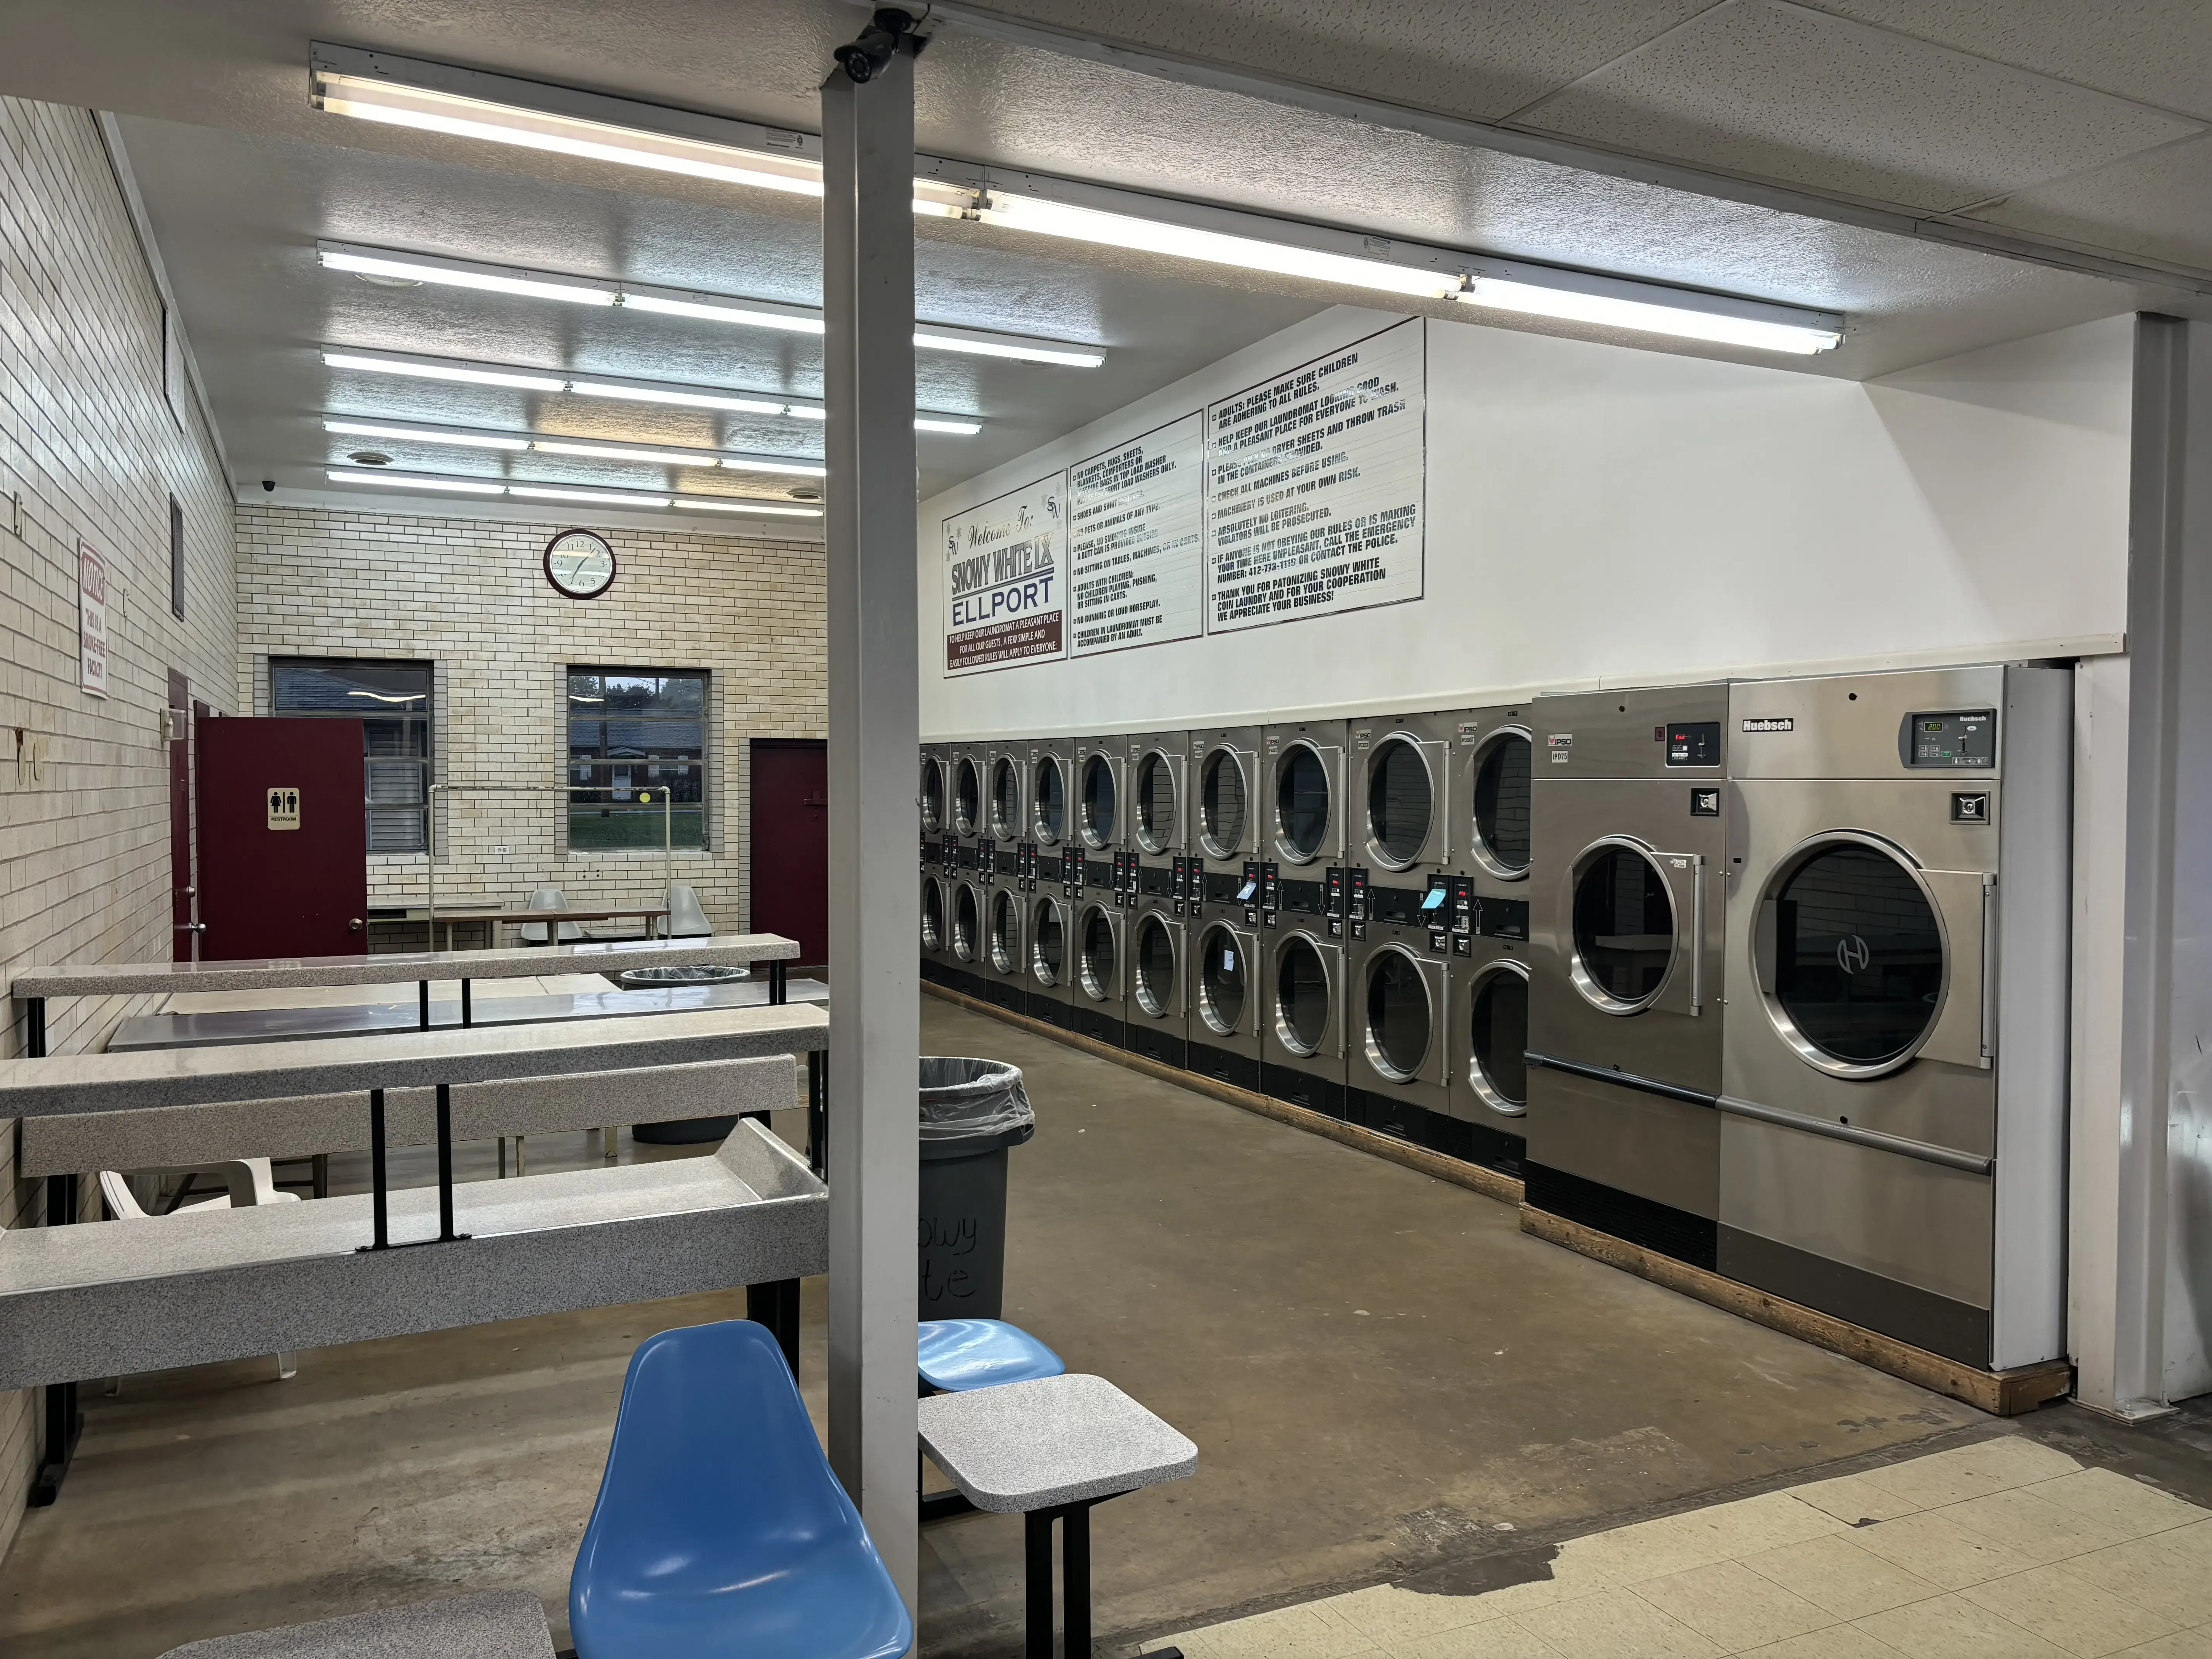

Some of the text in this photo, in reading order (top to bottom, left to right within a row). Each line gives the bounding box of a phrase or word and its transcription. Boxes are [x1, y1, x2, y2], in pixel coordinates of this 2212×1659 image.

[1219, 352, 1357, 419] ADULTS: PLEASE MAKE SURE CHILDREN
[1219, 381, 1319, 429] ARE ADHERING TO ALL RULES.
[1077, 471, 1083, 480] NO
[1085, 461, 1106, 477] CARPETS,
[1108, 454, 1121, 467] RUGS,
[1077, 455, 1142, 489] BLANKETS, COMFORTERS OR
[1218, 450, 1347, 501] CHECK ALL MACHINES BEFORE USING.
[1218, 467, 1360, 519] MACHINERY IS USED AT YOUR OWN RISK.
[1218, 501, 1308, 536] ABSOLUTELY NO LOITERING.
[1218, 507, 1331, 546] VIOLATORS WILL BE PROSECUTED.
[567, 541, 574, 550] 11
[968, 521, 1011, 549] Welcome
[952, 531, 1054, 595] SNOWY WHITE IX
[1077, 567, 1084, 576] NO
[1085, 561, 1102, 574] SITTING
[1104, 559, 1110, 568] ON
[1112, 553, 1131, 566] TABLES,
[1218, 569, 1247, 584] NUMBER:
[1311, 545, 1345, 562] CONTACT
[1348, 541, 1362, 554] THE
[1365, 533, 1397, 550] POLICE.
[83, 558, 103, 600] NOTICE
[1077, 570, 1133, 592] ADULTS WITH CHILDREN:
[1077, 573, 1156, 601] NO CHILDREN PLAYING, PUSHING,
[1218, 556, 1379, 600] THANK YOU FOR PATONIZING SNOWY WHITE
[1218, 568, 1385, 611] COIN LAUNDRY AND FOR YOUR COOPERATION
[953, 575, 1054, 627] ELLPORT
[1077, 590, 1127, 610] OR SITTING IN CARTS.
[1077, 599, 1159, 624] NO RUNNING OR LOUD HORSEPLAY.
[1218, 591, 1333, 622] WE APPRECIATE YOUR BUSINESS!
[85, 607, 101, 633] THIS IS A
[950, 612, 1058, 644] TO HELP KEEP OUR LAUNDROMAT A PLEASANT PLACE
[1077, 615, 1162, 639] CHILDREN IN LAUNDROMAT MUST BE
[83, 631, 105, 658] SMOKE-FREE
[975, 641, 984, 651] OUR
[1003, 636, 1006, 645] A
[1007, 634, 1017, 644] FEW
[1018, 631, 1033, 642] SIMPLE
[1034, 629, 1045, 639] AND
[1077, 628, 1142, 648] ACCOMPANIED BY AN ADULT.
[87, 657, 103, 679] FACILITY
[950, 658, 962, 668] EASILY
[962, 654, 984, 666] FOLLOWED
[985, 652, 997, 662] RULES
[998, 649, 1008, 659] WILL
[1009, 647, 1022, 658] APPLY
[1024, 646, 1030, 655] TO
[1743, 719, 1792, 731] Huebsch
[918, 1217, 977, 1255] owy
